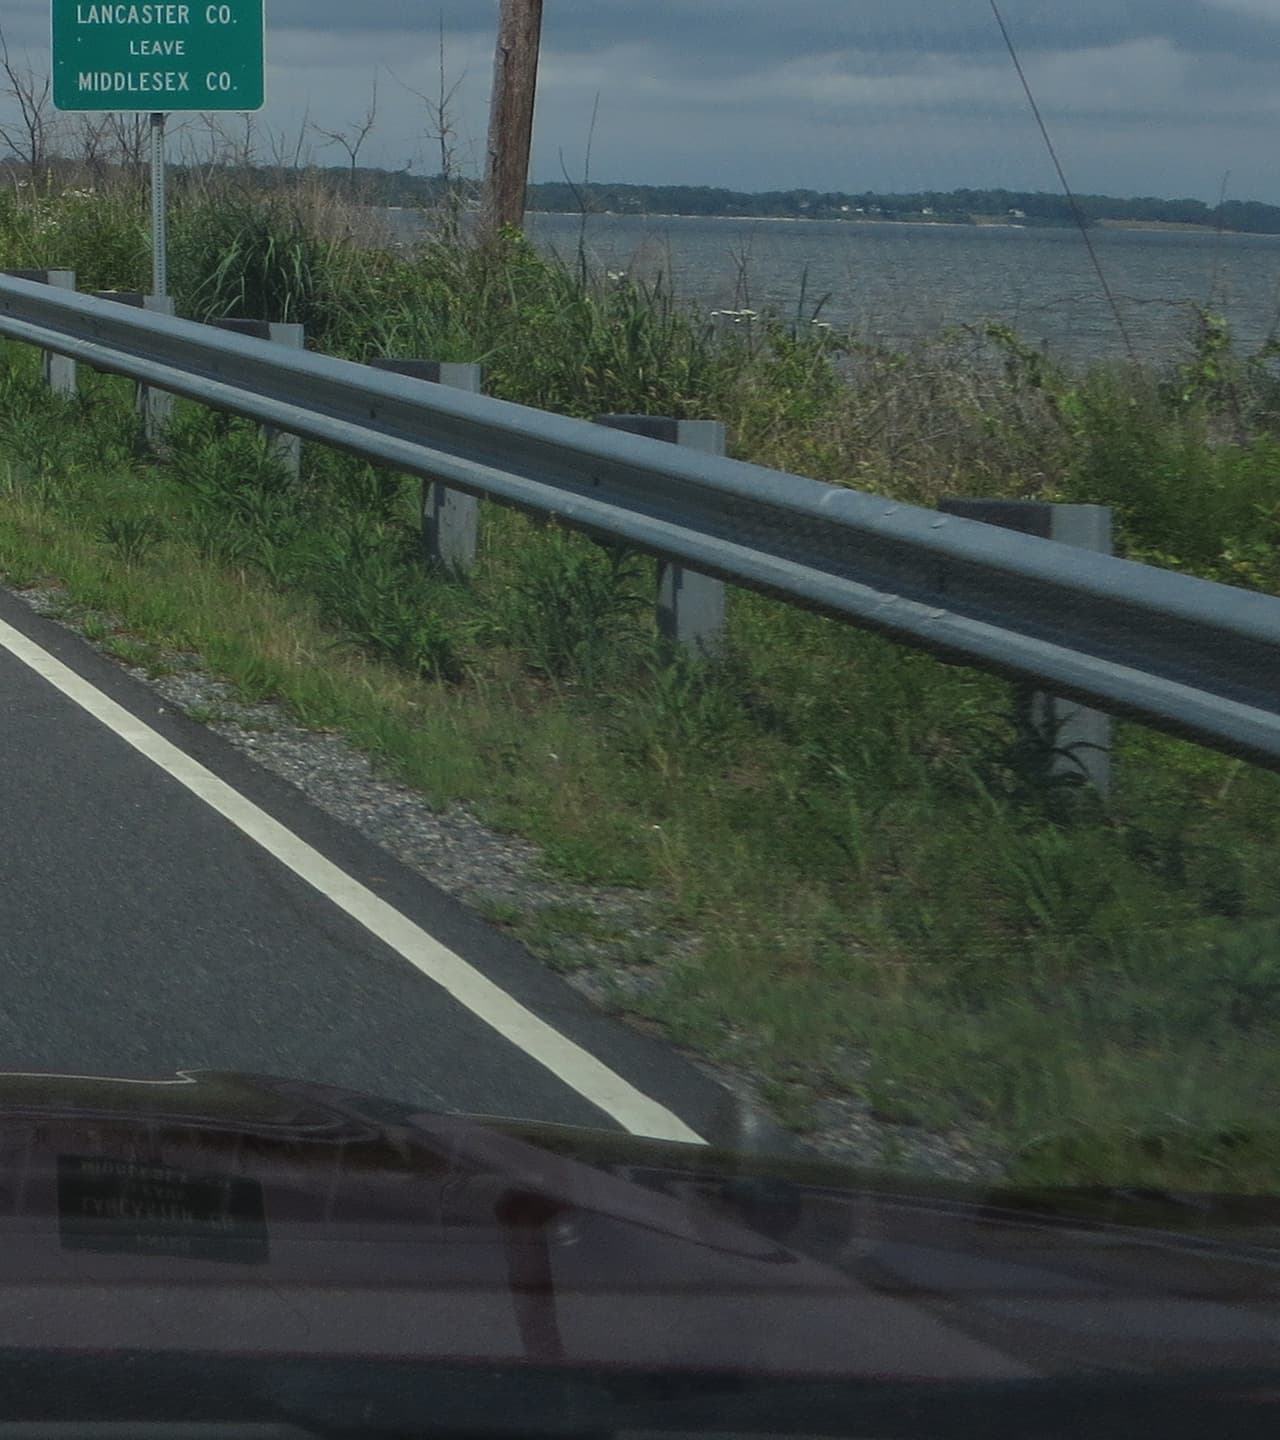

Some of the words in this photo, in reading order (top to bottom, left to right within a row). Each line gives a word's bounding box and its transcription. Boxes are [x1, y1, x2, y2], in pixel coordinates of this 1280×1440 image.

[77, 4, 190, 24] LANCASTER
[205, 5, 238, 24] CO.
[129, 40, 185, 55] LEAVE
[78, 71, 190, 92] MIDDLESEX
[205, 72, 238, 92] CO.
